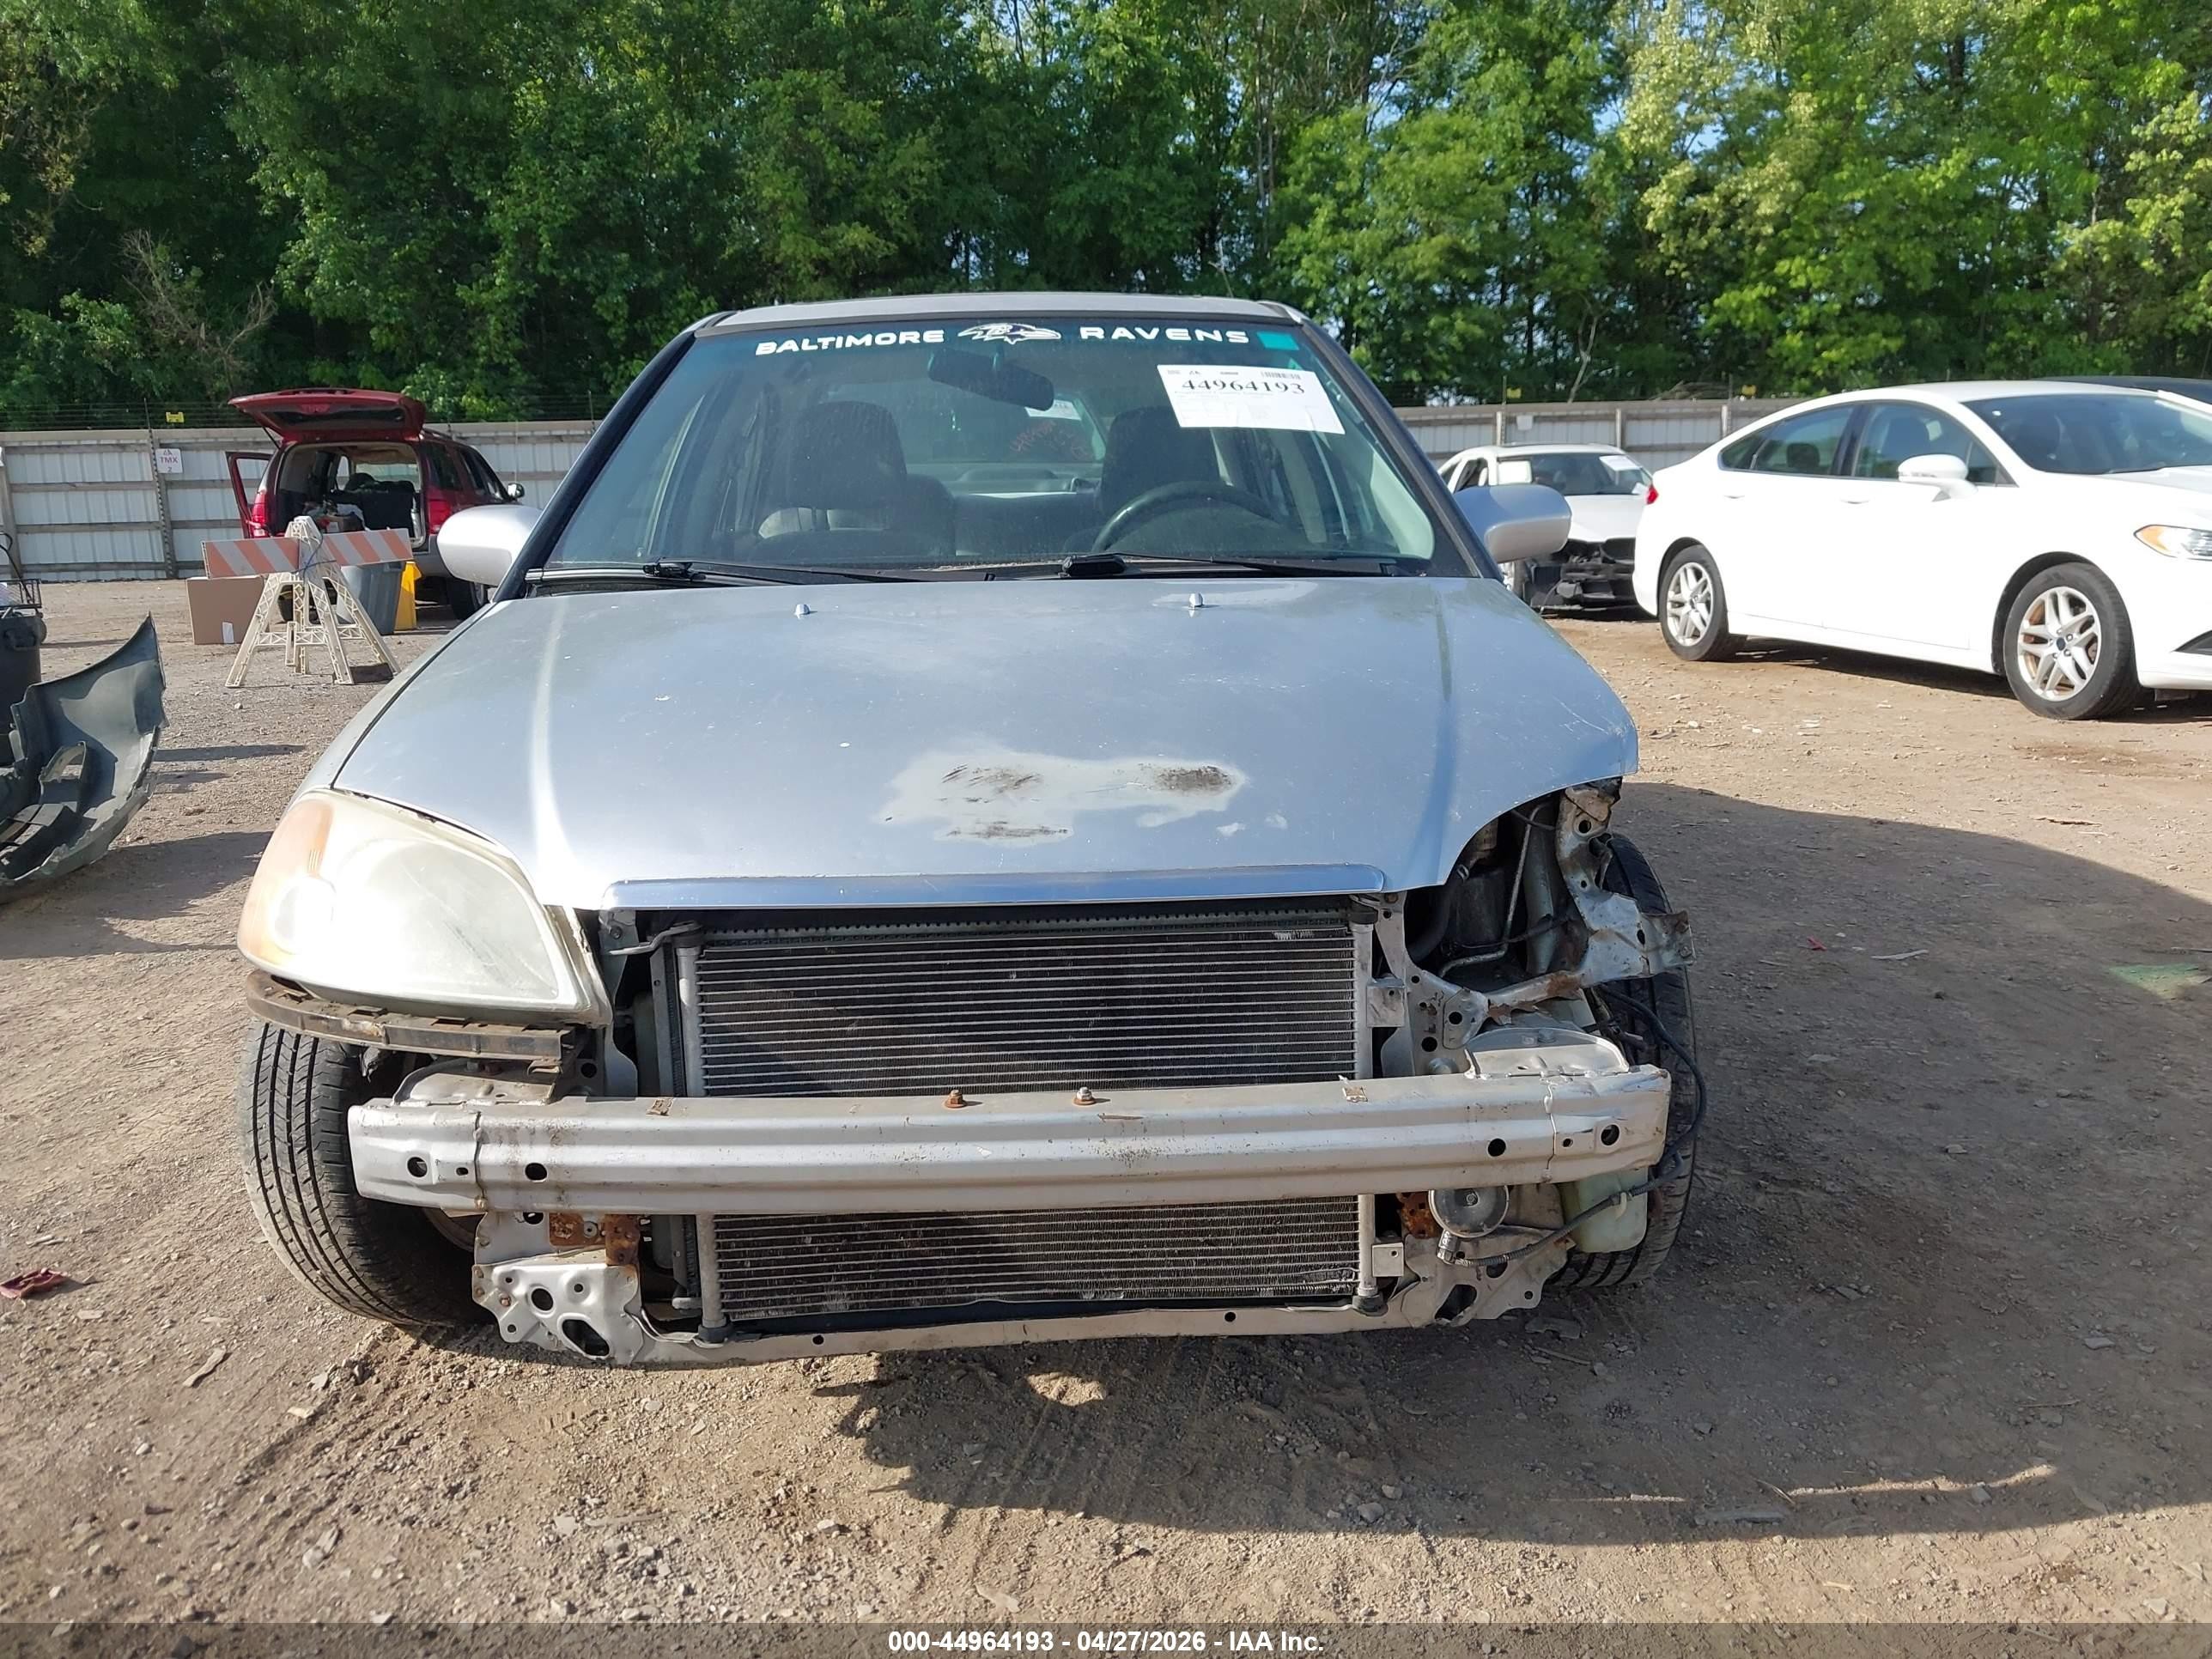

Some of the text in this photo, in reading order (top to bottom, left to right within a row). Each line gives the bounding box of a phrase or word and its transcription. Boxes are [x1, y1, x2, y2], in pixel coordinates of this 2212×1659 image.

[755, 327, 1249, 356] BALTIMORE RAVENS
[1182, 380, 1305, 394] 44964193
